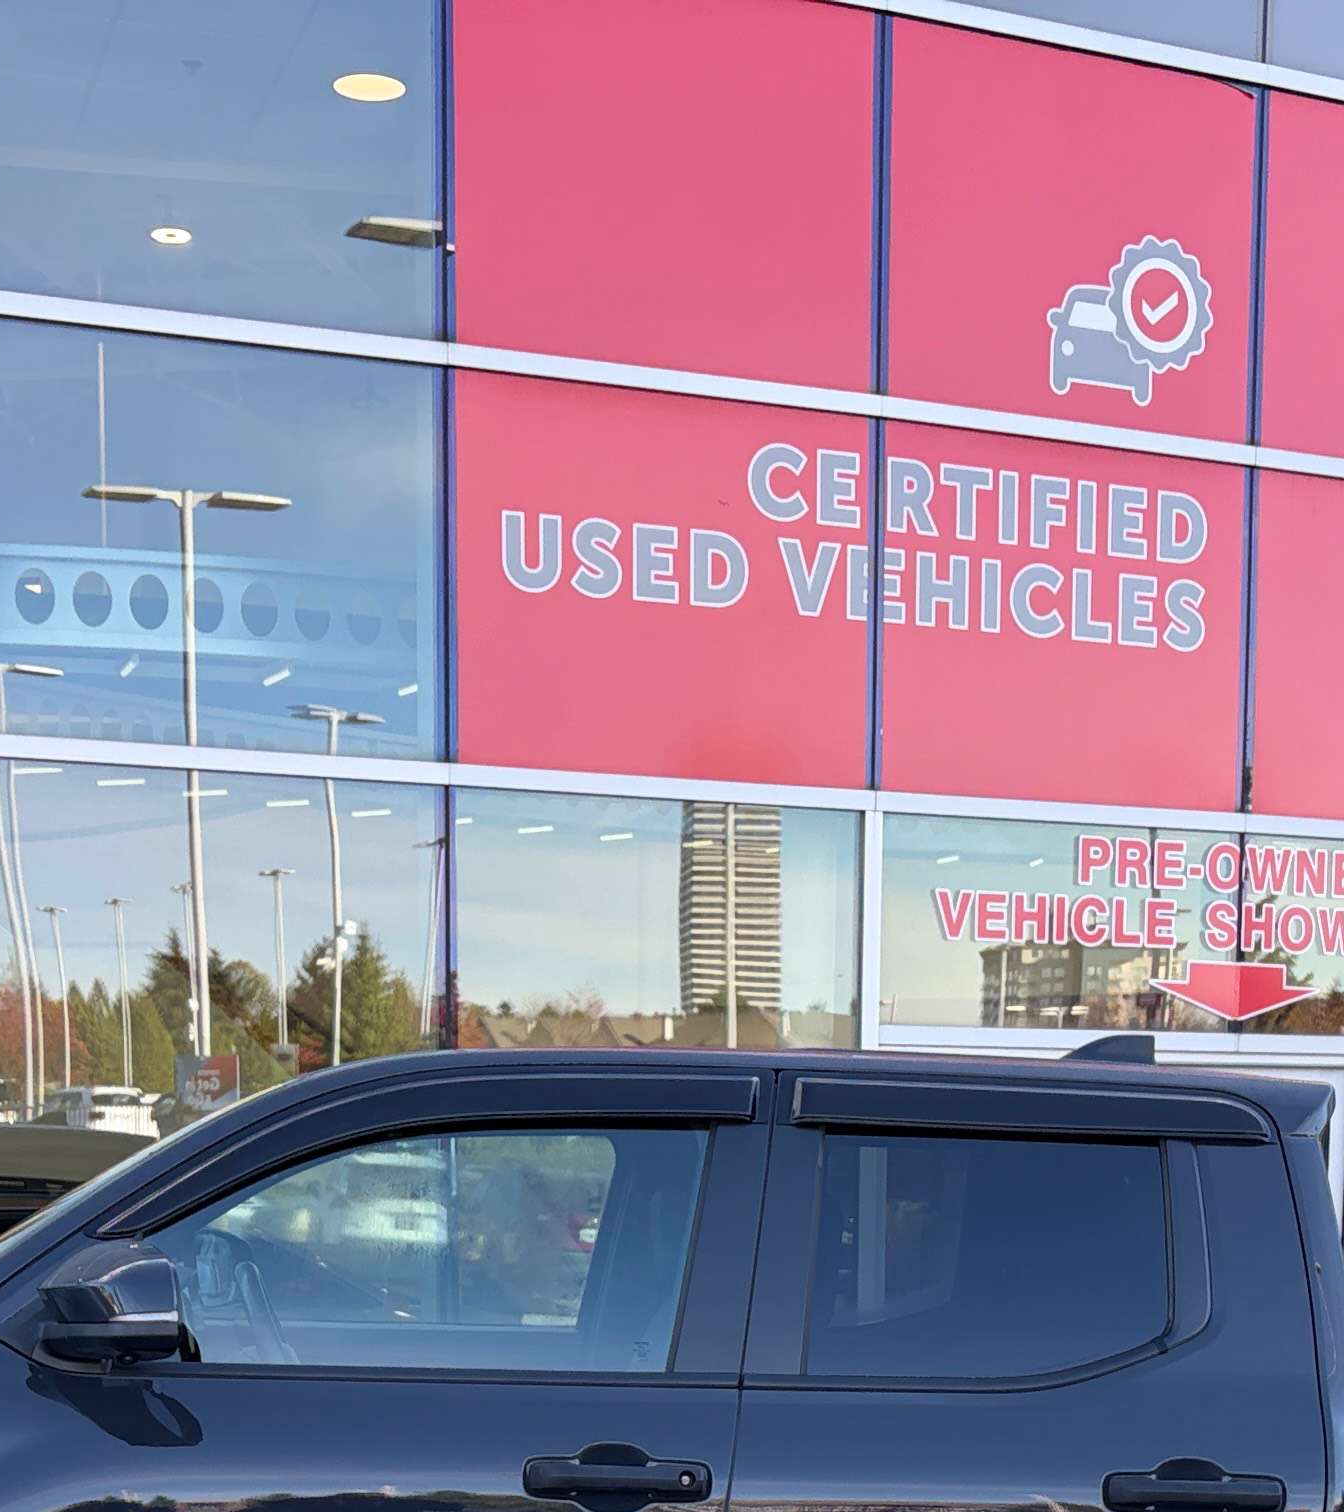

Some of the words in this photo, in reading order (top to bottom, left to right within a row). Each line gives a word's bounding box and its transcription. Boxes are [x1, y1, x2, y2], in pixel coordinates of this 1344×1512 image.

[747, 442, 1208, 564] CERTIFIED
[500, 510, 749, 609] USED
[778, 536, 1207, 653] VEHICLES
[935, 888, 1179, 949] VEHICLE
